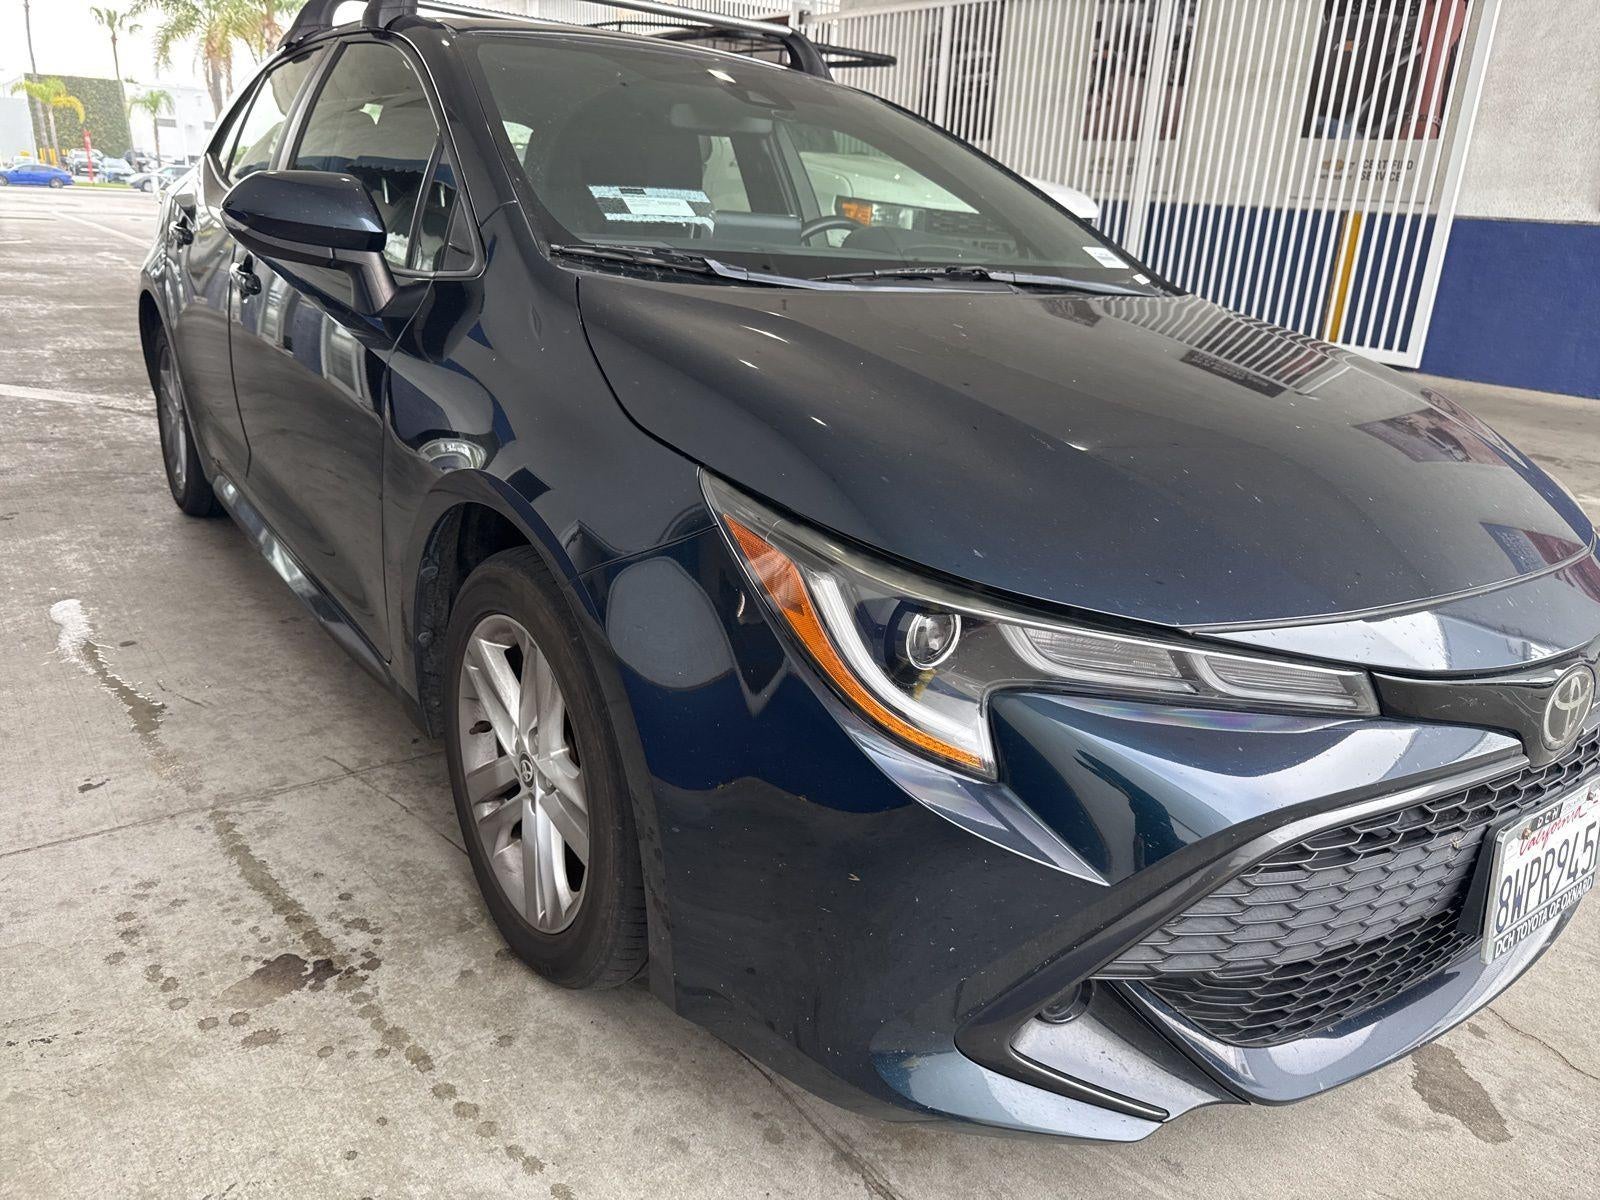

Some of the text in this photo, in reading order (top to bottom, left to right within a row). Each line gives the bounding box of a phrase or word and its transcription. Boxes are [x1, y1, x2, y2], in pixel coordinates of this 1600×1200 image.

[1363, 159, 1414, 170] CERTFID
[1360, 171, 1401, 182] SERVCE
[1536, 806, 1560, 829] DCH
[1495, 821, 1597, 934] 8WPR945
[1494, 875, 1593, 959] DCH TOYOTA OF OXNARD
